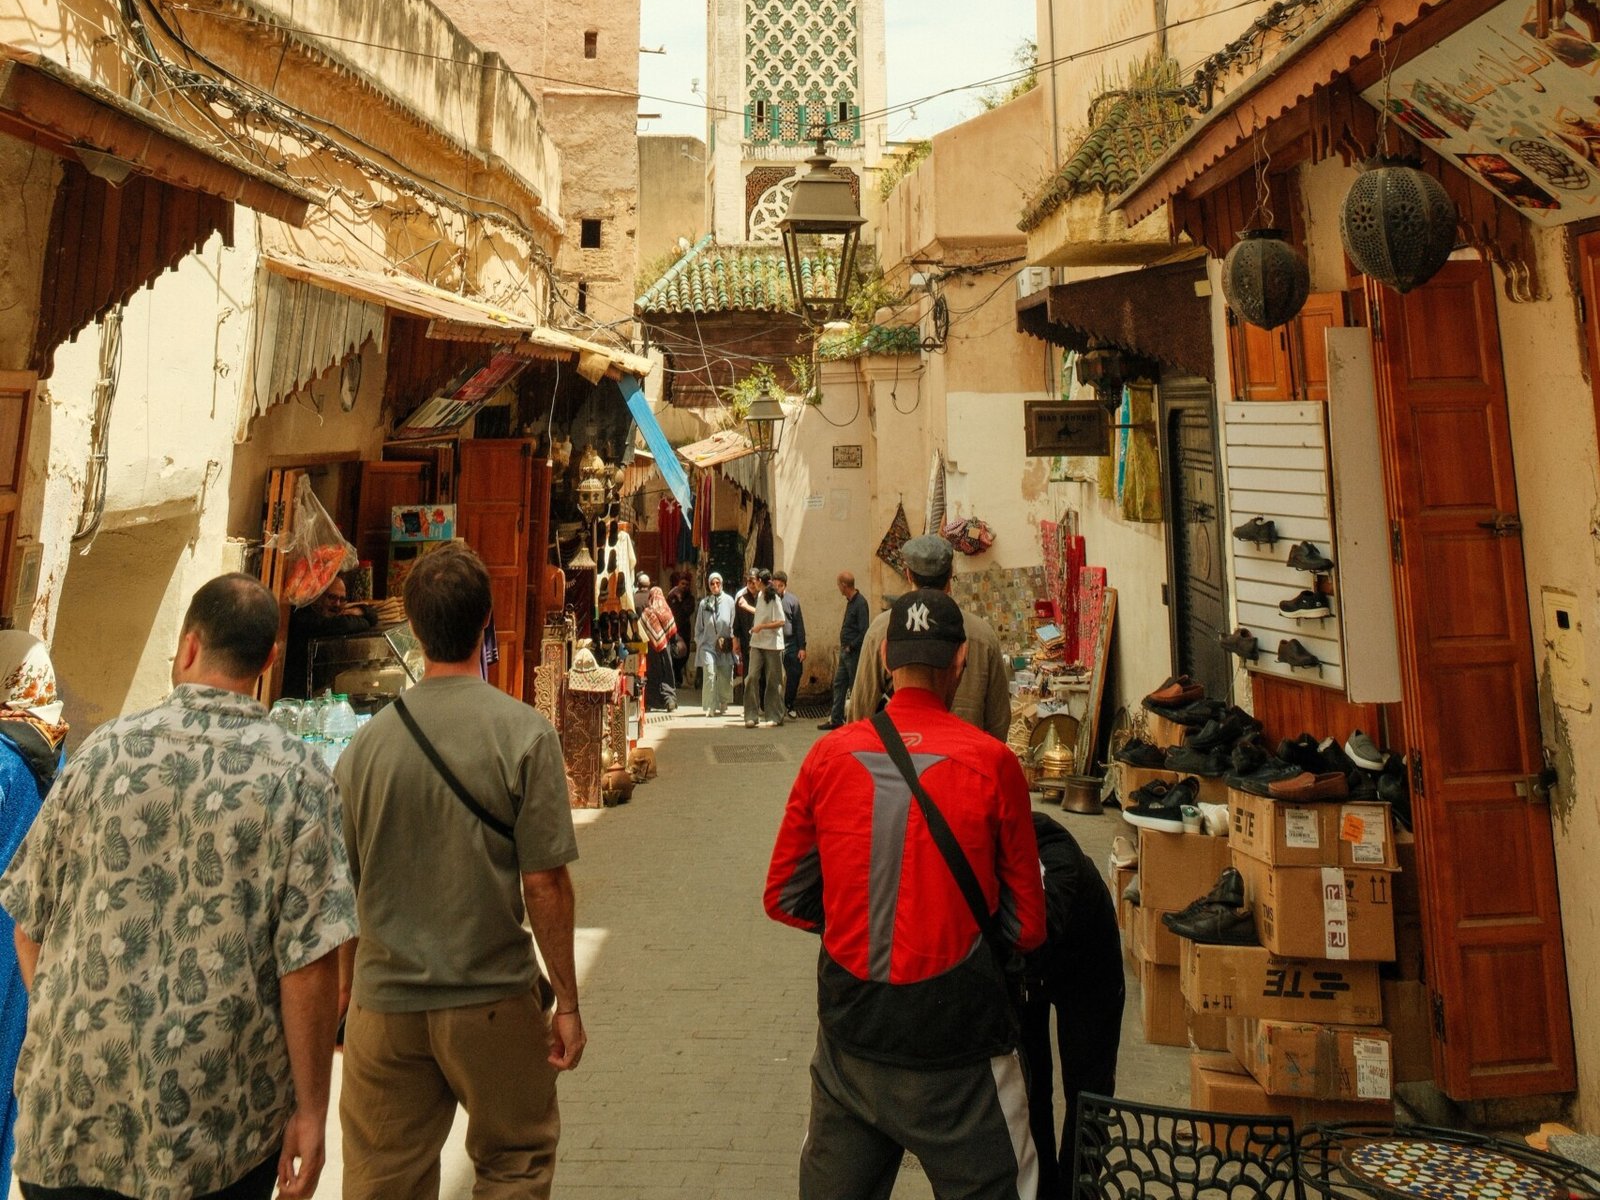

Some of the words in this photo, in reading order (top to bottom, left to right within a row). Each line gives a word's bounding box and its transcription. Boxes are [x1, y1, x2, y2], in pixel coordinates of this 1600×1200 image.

[905, 602, 930, 632] NY
[1244, 810, 1255, 838] TE
[1262, 903, 1274, 922] TMS
[1263, 969, 1305, 998] TE
